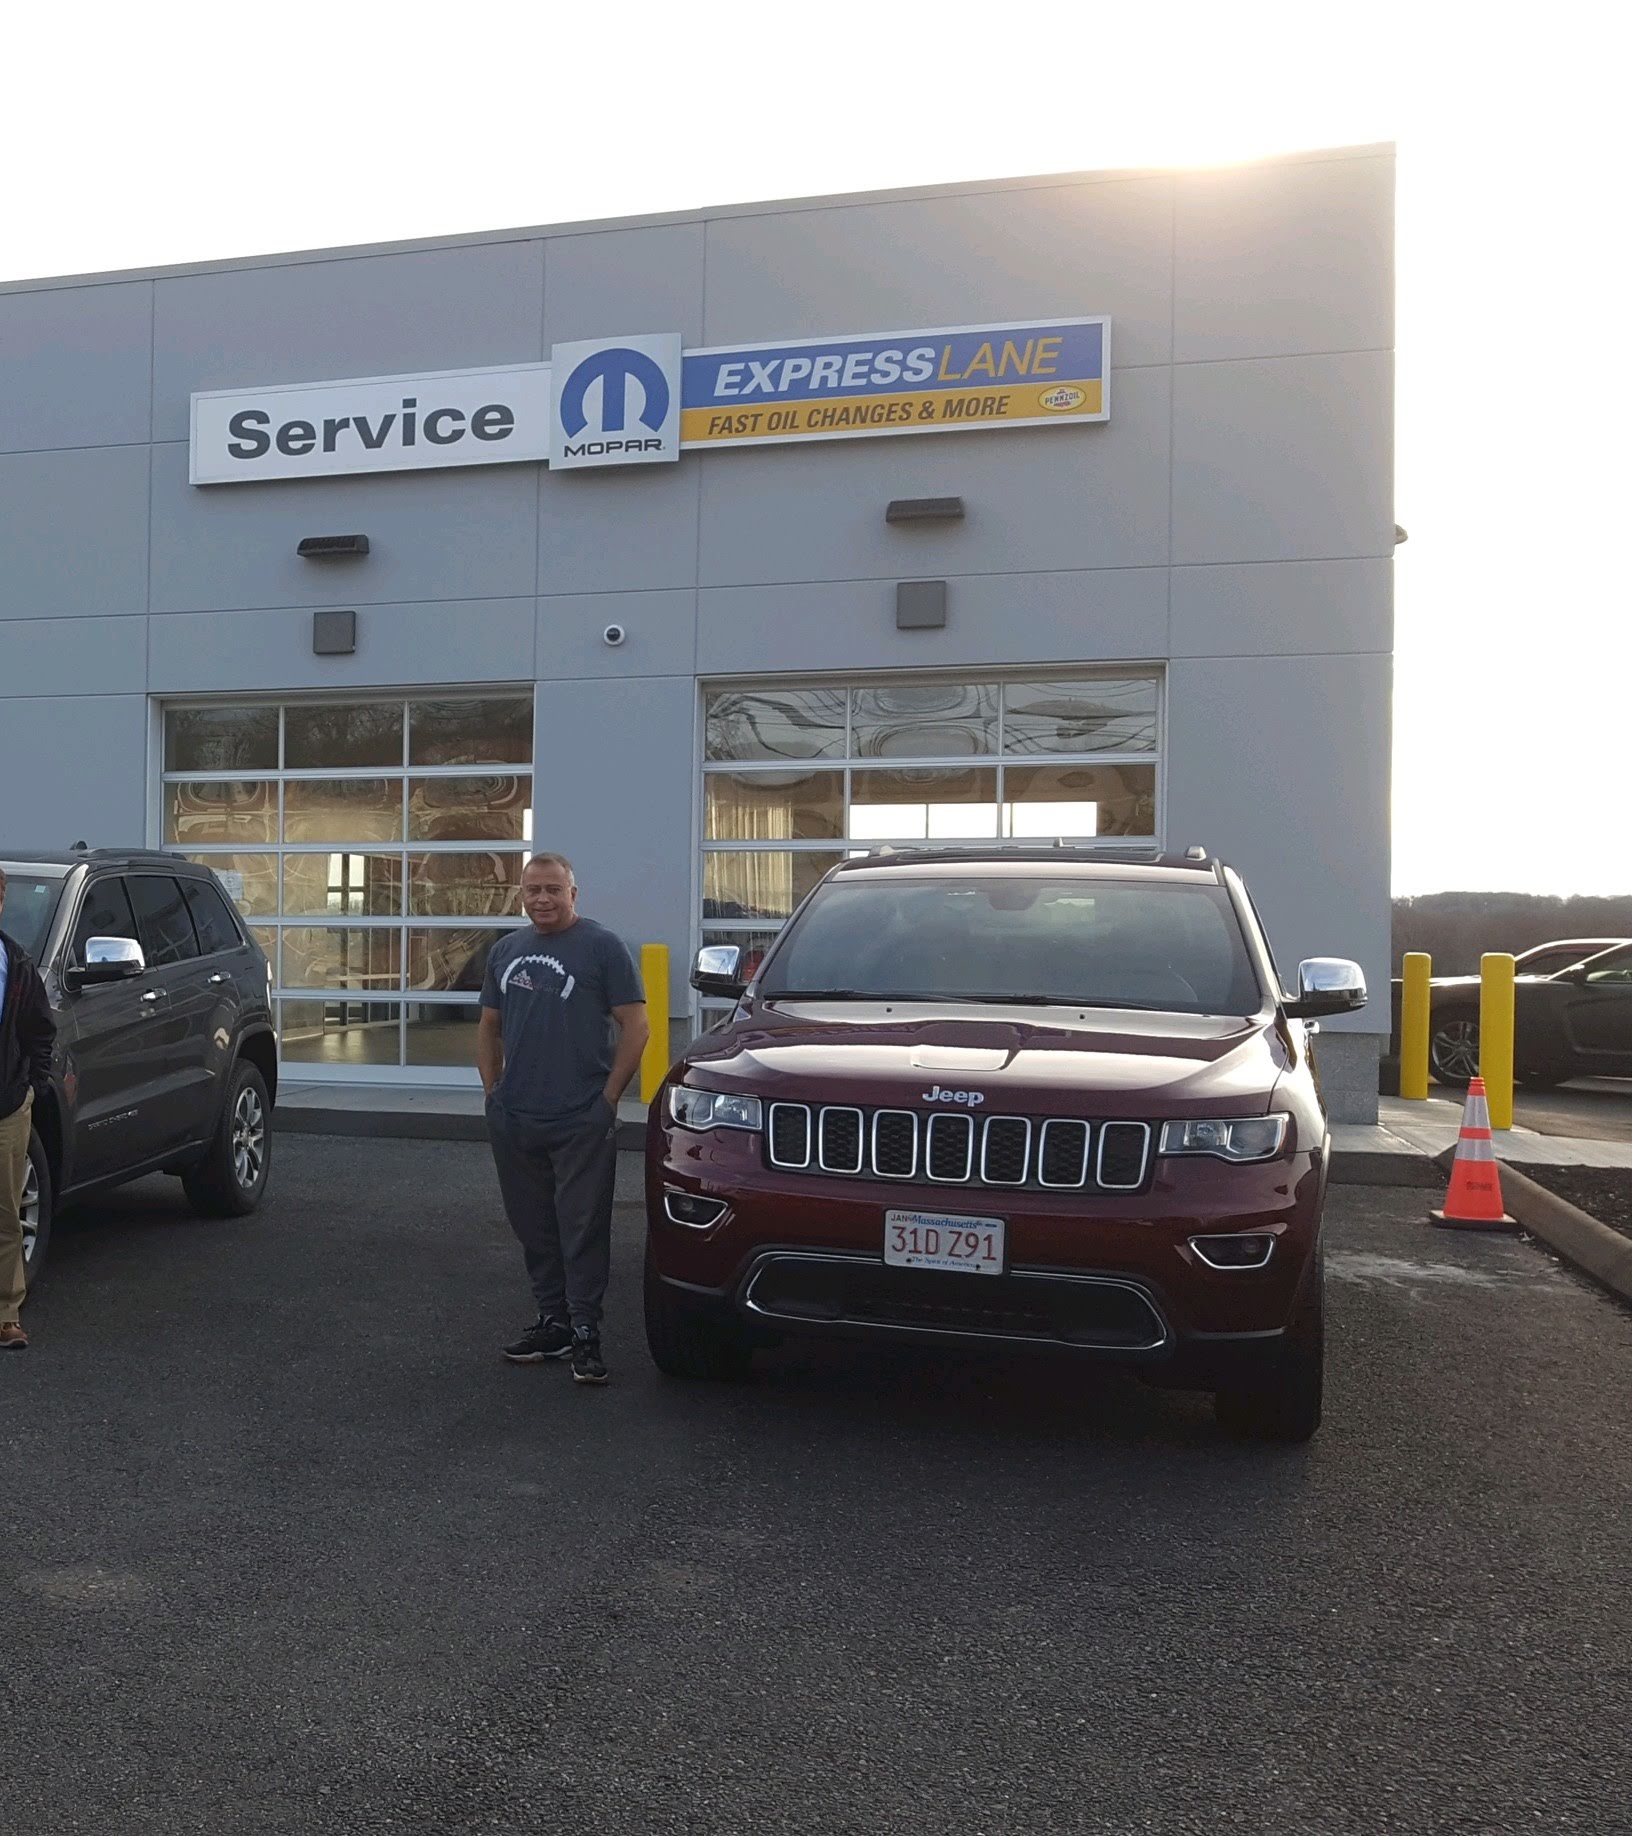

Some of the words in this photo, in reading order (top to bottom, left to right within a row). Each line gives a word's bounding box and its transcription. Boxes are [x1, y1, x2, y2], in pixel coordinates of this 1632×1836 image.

[1044, 391, 1080, 406] PENNZOIL
[227, 397, 515, 460] Service
[708, 413, 763, 435] FAST
[768, 410, 799, 431] OIL
[807, 402, 914, 428] CHANGES
[918, 400, 935, 420] &
[942, 395, 1011, 419] MORE
[564, 438, 662, 458] MOPAR
[922, 1085, 984, 1107] Jeep
[891, 1225, 939, 1256] 31D
[948, 1230, 997, 1261] Z91
